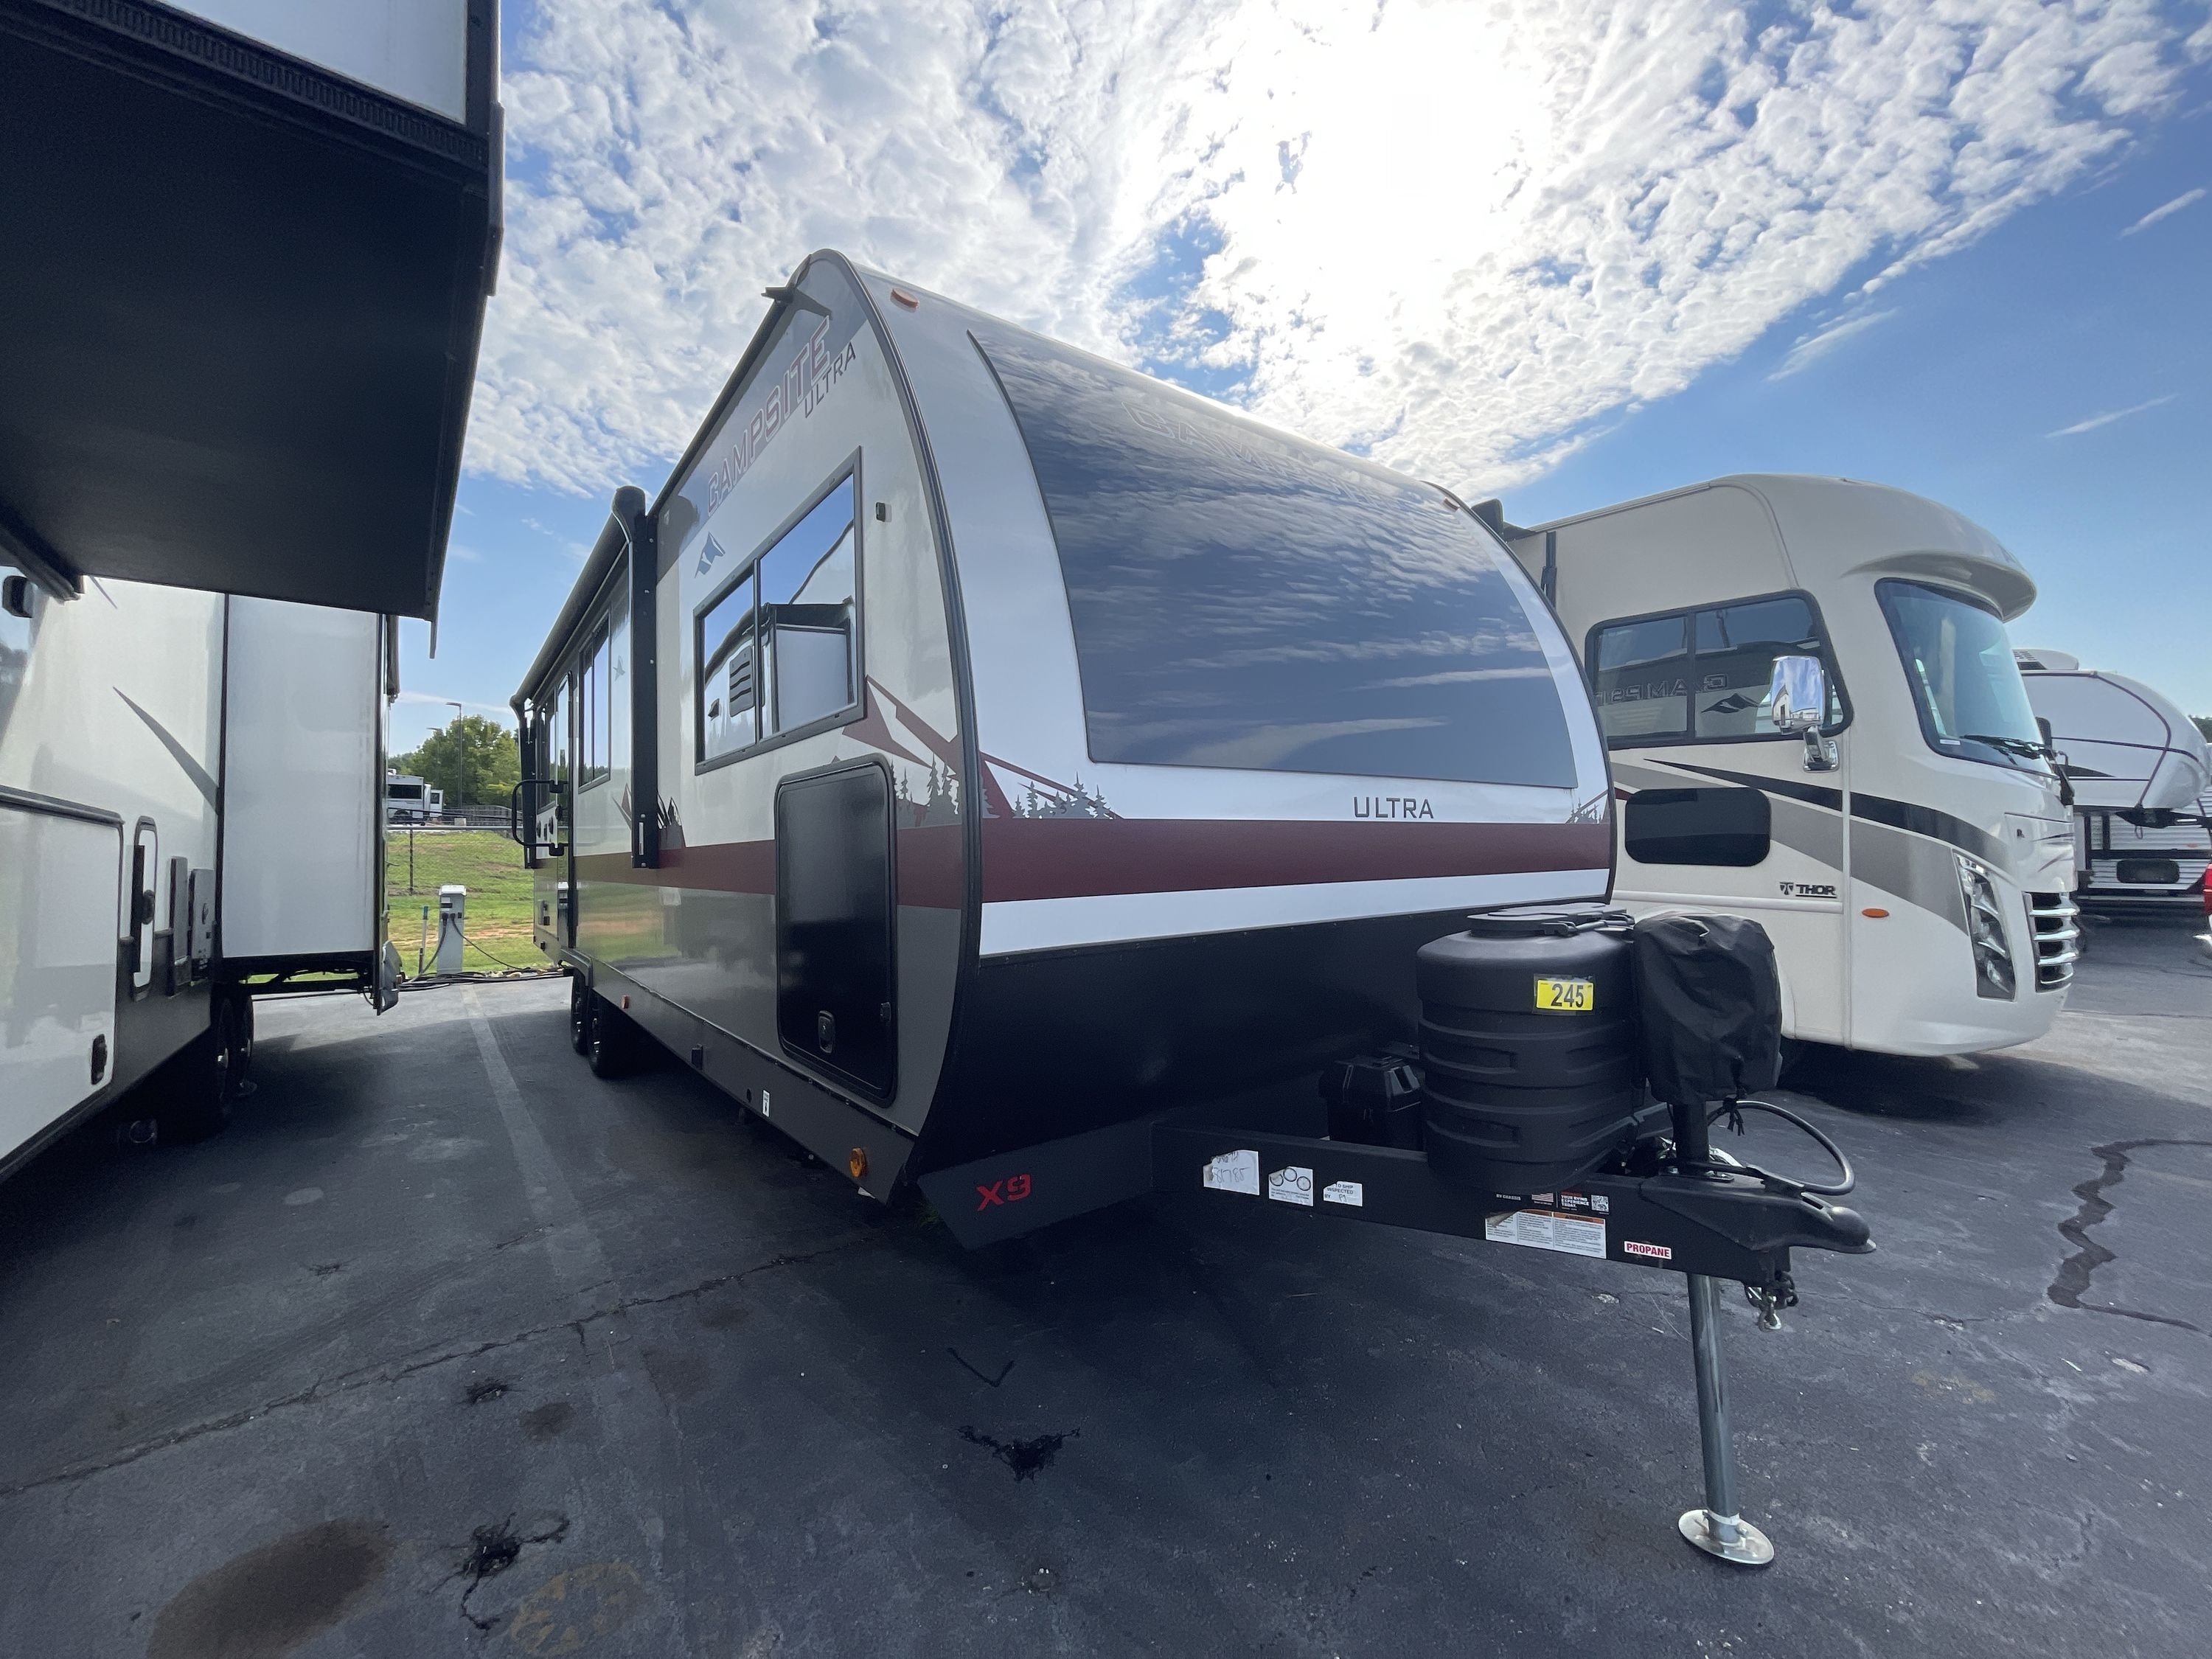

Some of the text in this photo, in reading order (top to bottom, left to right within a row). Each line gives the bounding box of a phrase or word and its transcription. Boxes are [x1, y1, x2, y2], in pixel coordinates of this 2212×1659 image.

[804, 341, 857, 419] ULTRA
[707, 315, 830, 518] CAMPSITE
[1353, 796, 1434, 819] ULTRA
[1795, 883, 1837, 896] THOR
[1551, 983, 1584, 1008] 245
[976, 1173, 1031, 1211] X9
[1627, 1242, 1670, 1257] PROPANE
